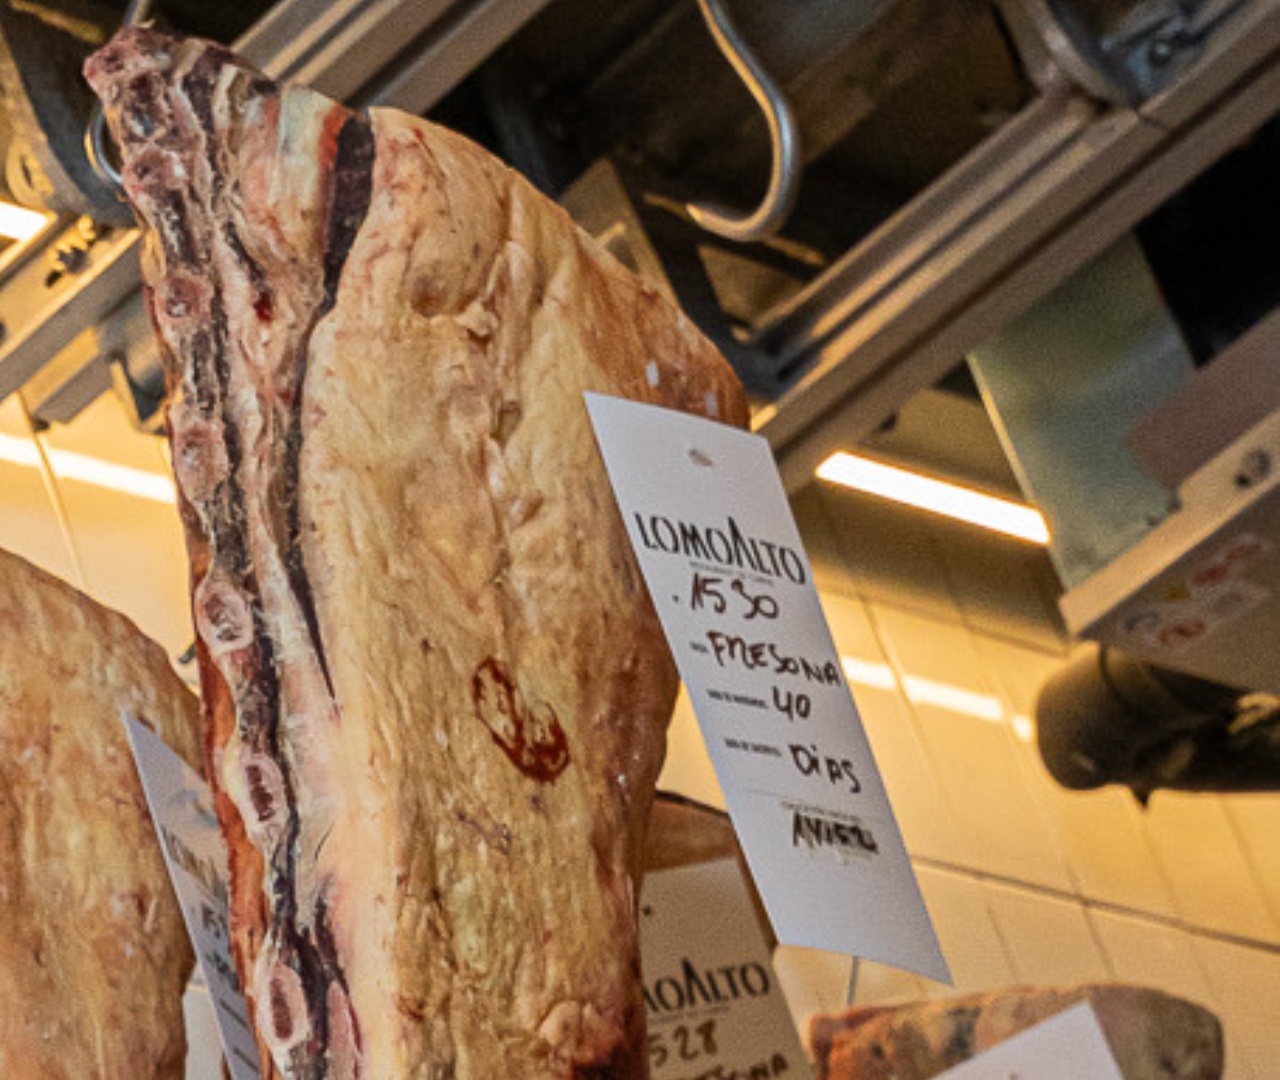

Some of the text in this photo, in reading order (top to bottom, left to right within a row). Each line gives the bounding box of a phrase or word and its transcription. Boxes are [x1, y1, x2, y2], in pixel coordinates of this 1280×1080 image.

[634, 511, 806, 585] LOMOALTO
[691, 572, 779, 620] 1530
[772, 685, 812, 722] 40
